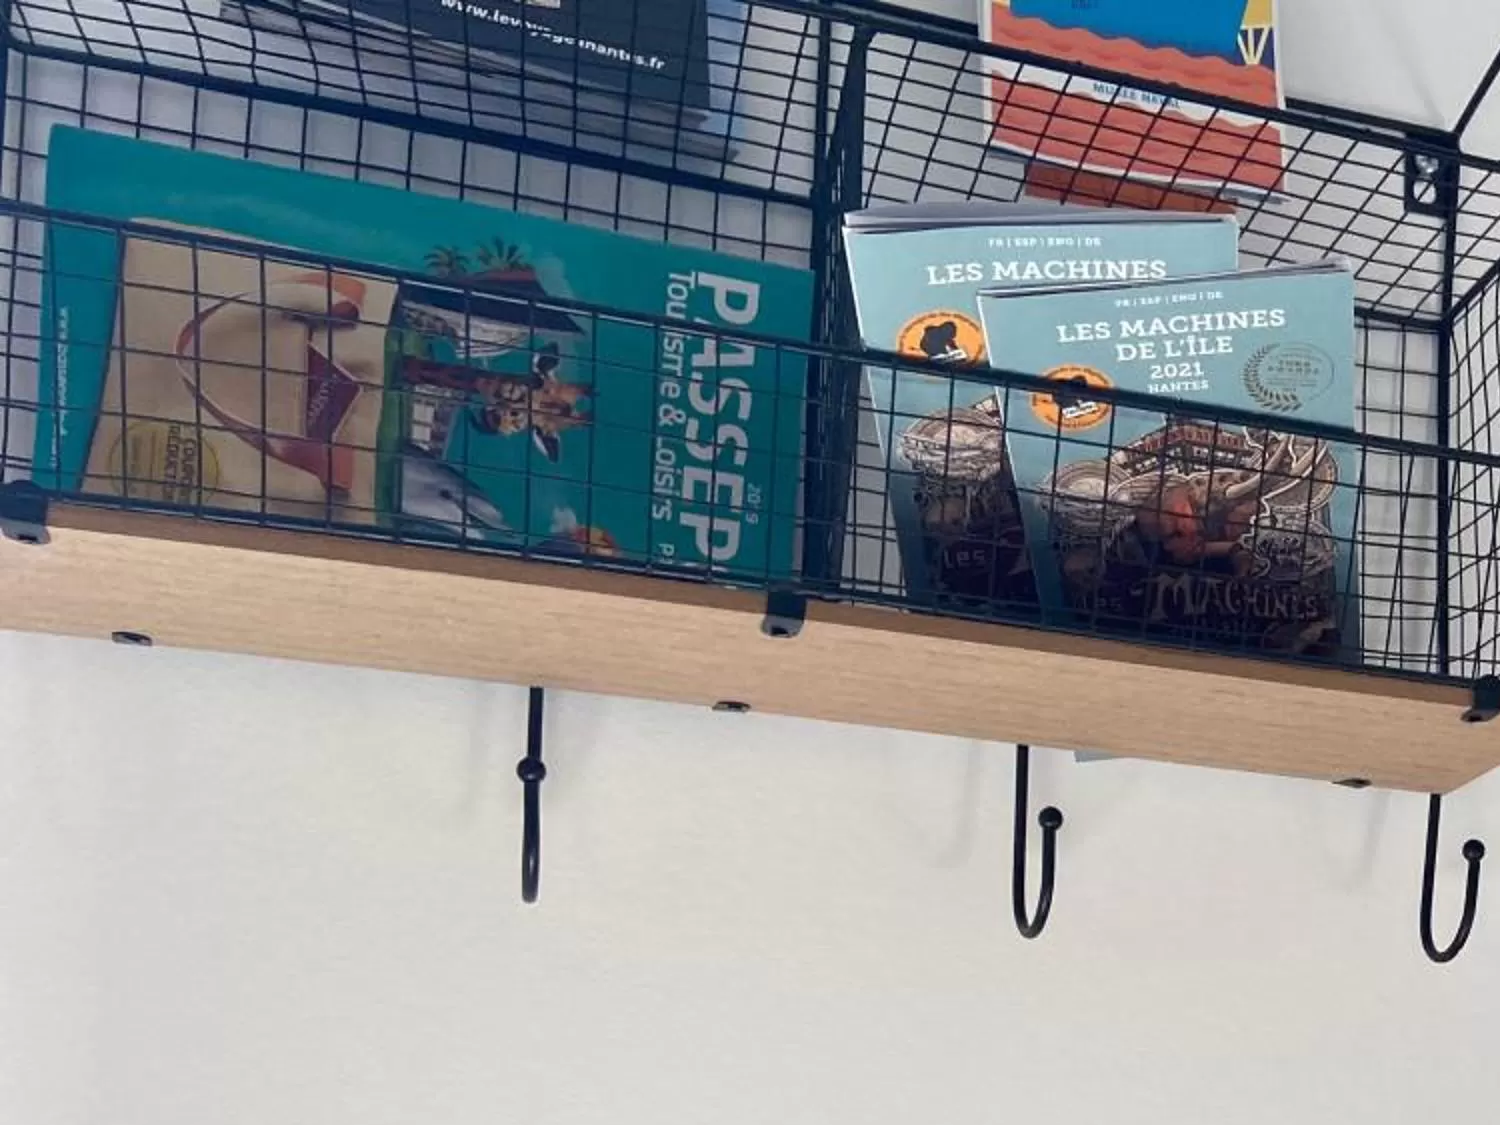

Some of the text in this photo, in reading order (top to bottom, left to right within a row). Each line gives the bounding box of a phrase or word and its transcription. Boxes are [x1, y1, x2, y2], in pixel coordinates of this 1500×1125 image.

[926, 259, 1168, 286] LES MACHINES
[1056, 308, 1287, 344] LES MACHINES
[1114, 334, 1235, 363] DE L'ÎLE
[1151, 360, 1205, 381] 2021
[658, 403, 687, 427] &
[679, 270, 761, 565] PASSEP
